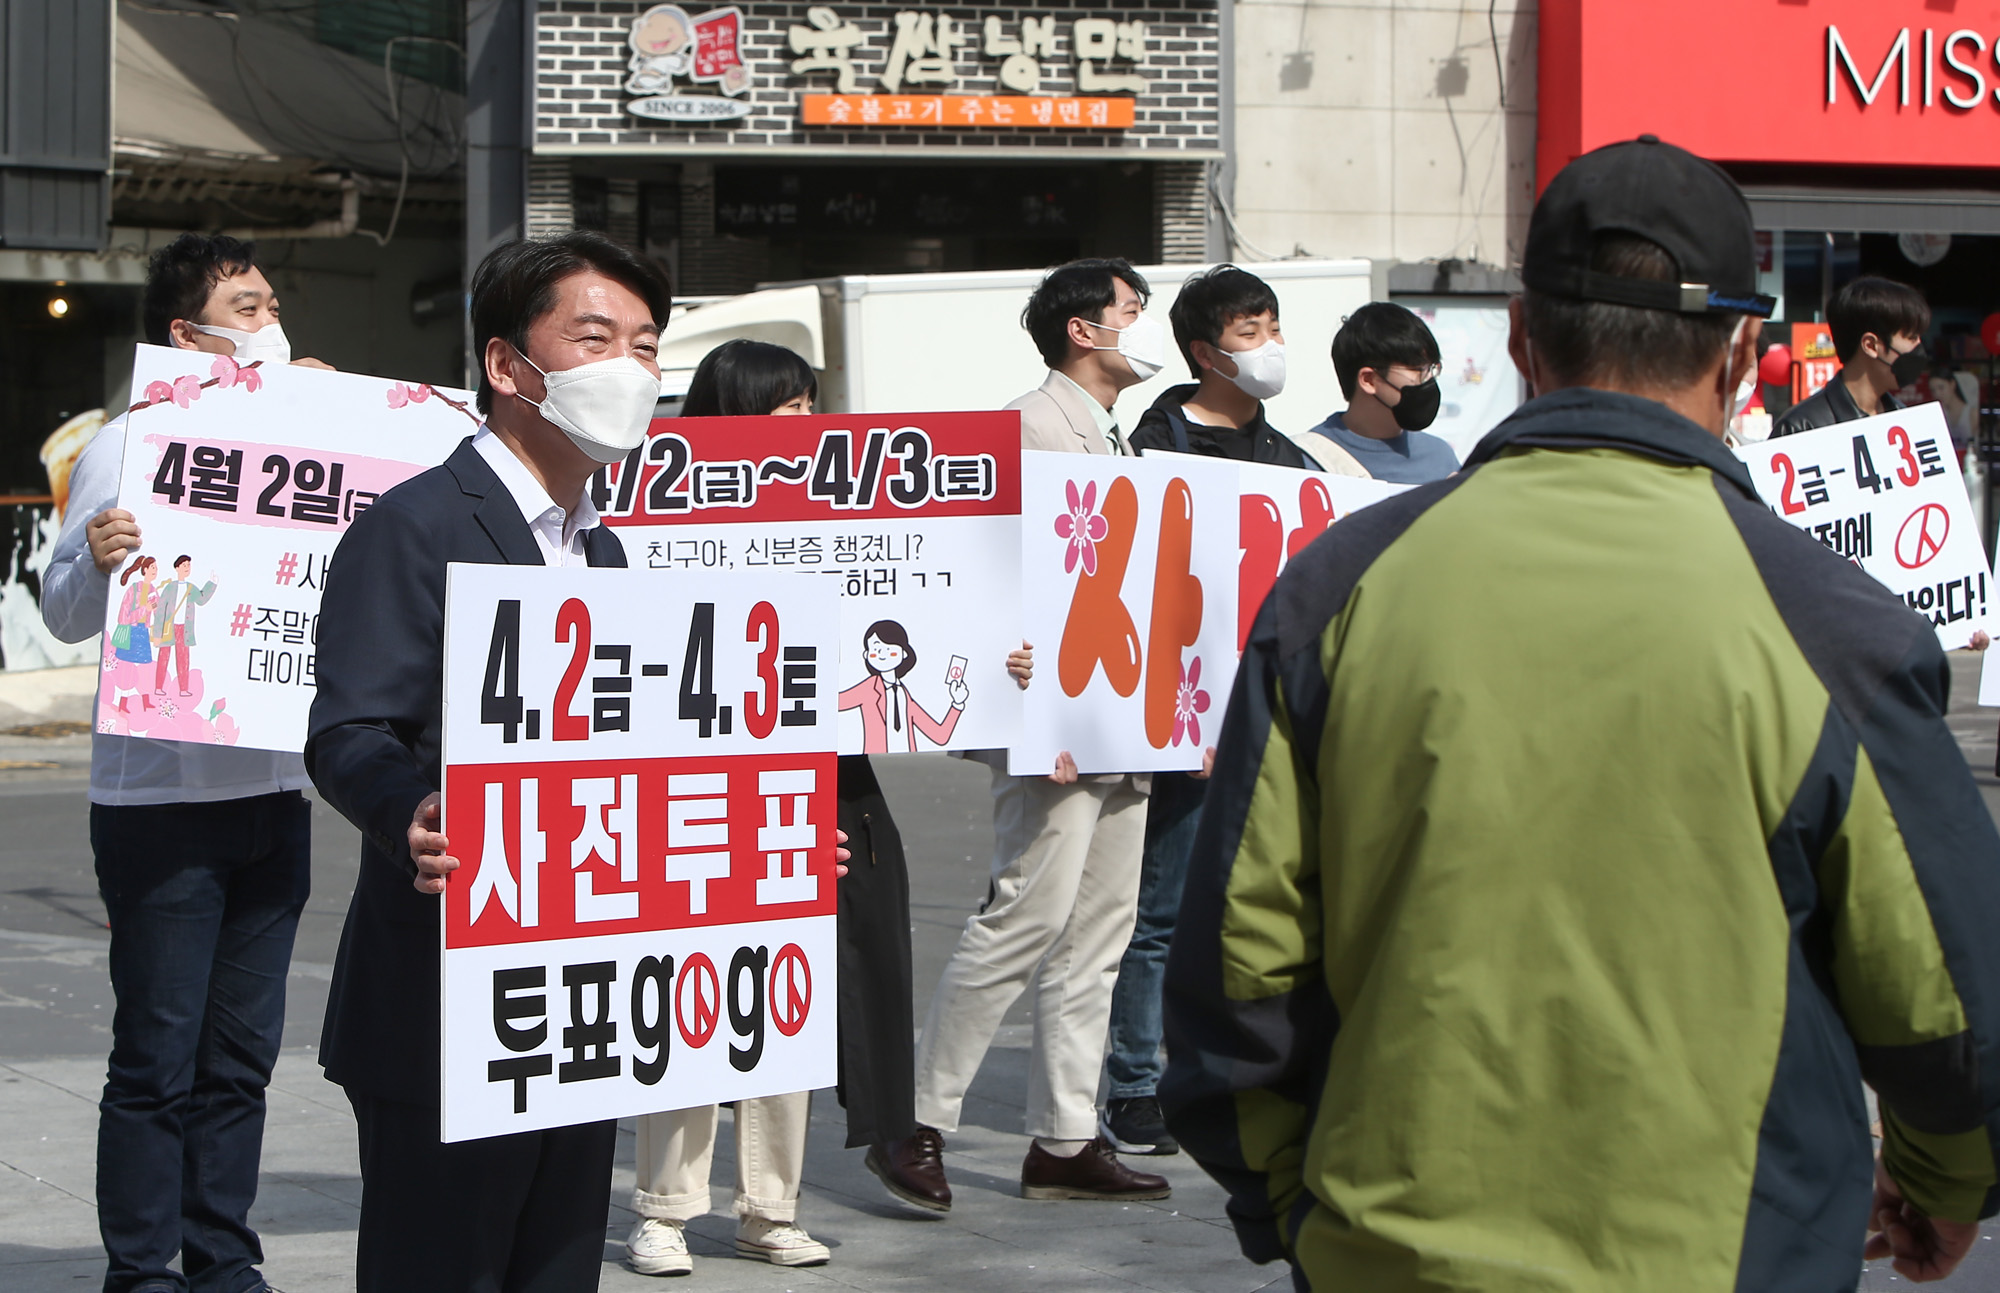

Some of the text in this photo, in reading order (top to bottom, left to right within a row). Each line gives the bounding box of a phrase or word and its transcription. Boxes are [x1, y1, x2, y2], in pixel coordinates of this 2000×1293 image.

[790, 6, 1146, 94] 육쌈냉면
[1825, 25, 2000, 108] MIS
[644, 100, 736, 115] SINCE 2006
[827, 97, 1109, 125] 숯불고기 주는 냉면집
[152, 441, 244, 514] 4월
[646, 533, 924, 570] 친구야, 신분증 챙겼니?
[1901, 571, 1987, 629] 있다!
[469, 768, 819, 928] 사전투표
